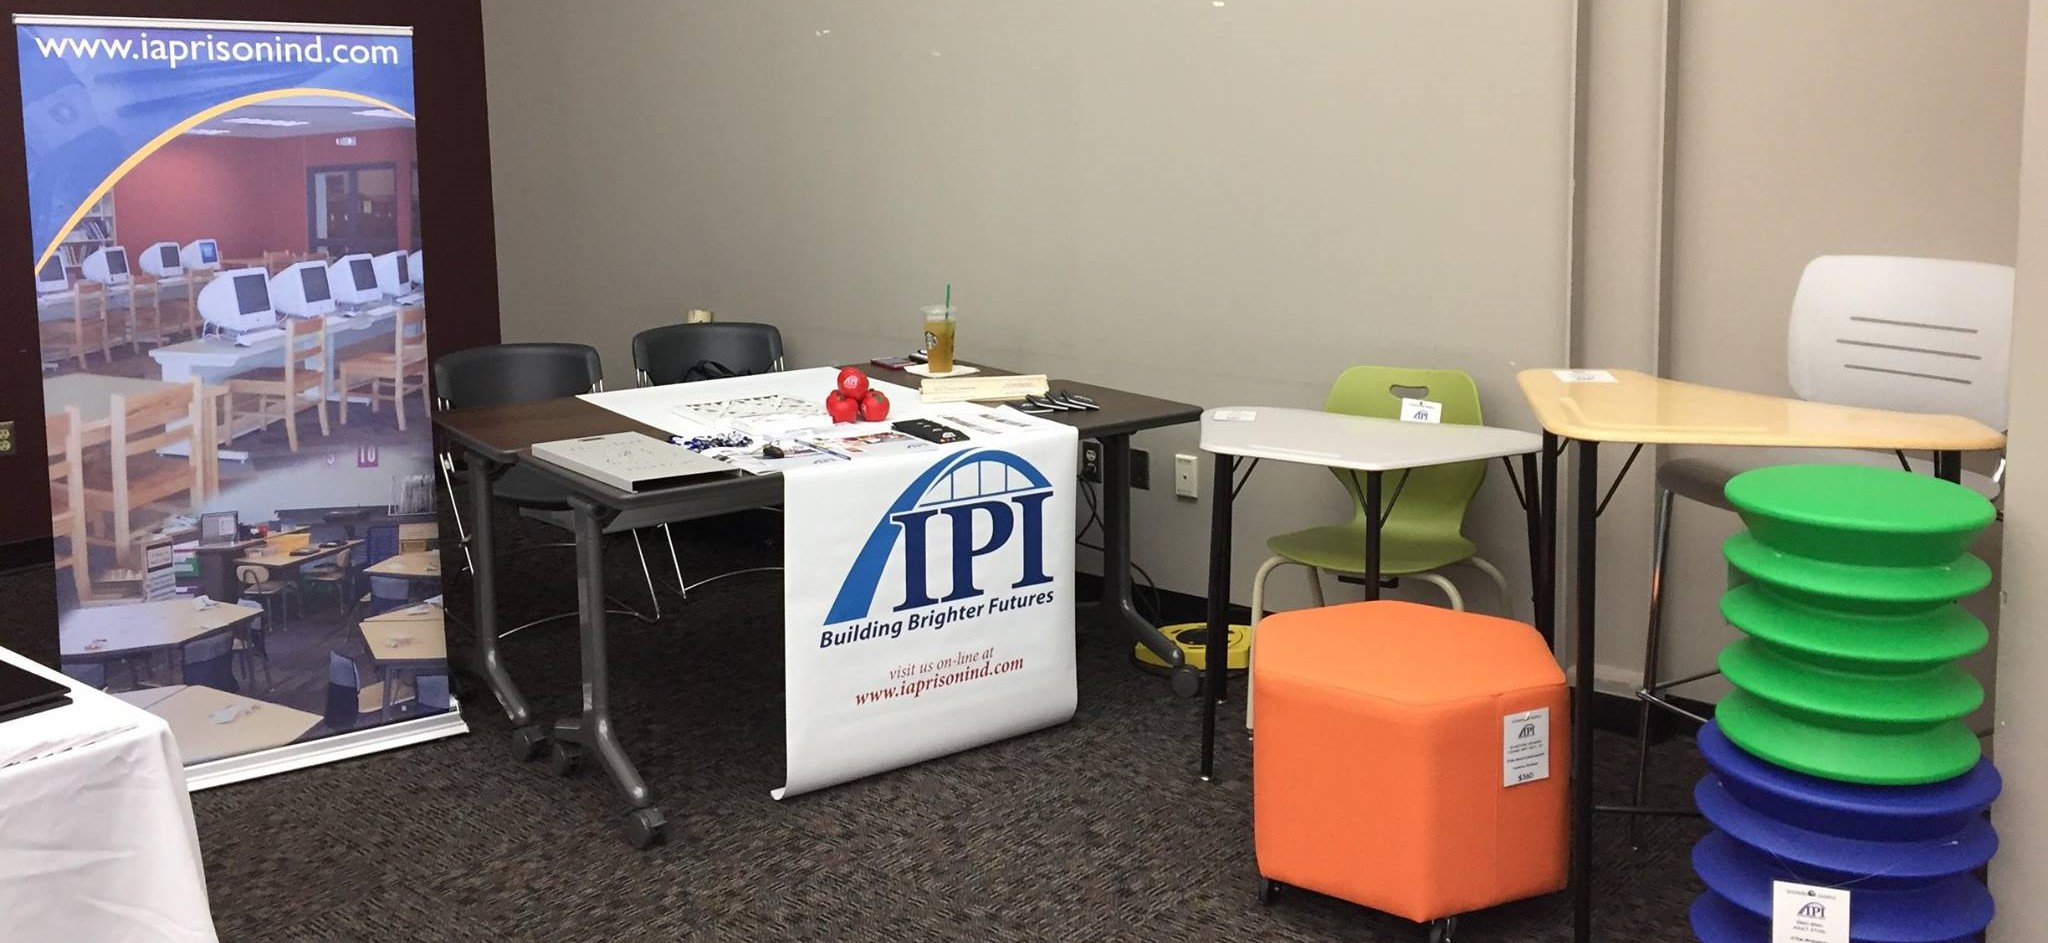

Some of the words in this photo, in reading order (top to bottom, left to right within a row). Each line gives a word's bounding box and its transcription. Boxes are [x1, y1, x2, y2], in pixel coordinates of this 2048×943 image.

[35, 33, 398, 69] www.iaprisonind.com
[892, 491, 1054, 613] IPI
[820, 611, 903, 648] Building
[908, 603, 984, 631] Brighter
[988, 590, 1054, 615] Futures
[855, 656, 1024, 706] www.iaprisonind.com
[889, 666, 916, 680] visit
[919, 663, 934, 673] us
[936, 651, 979, 670] on-line
[982, 647, 994, 660] at
[1803, 903, 1826, 918] IPI
